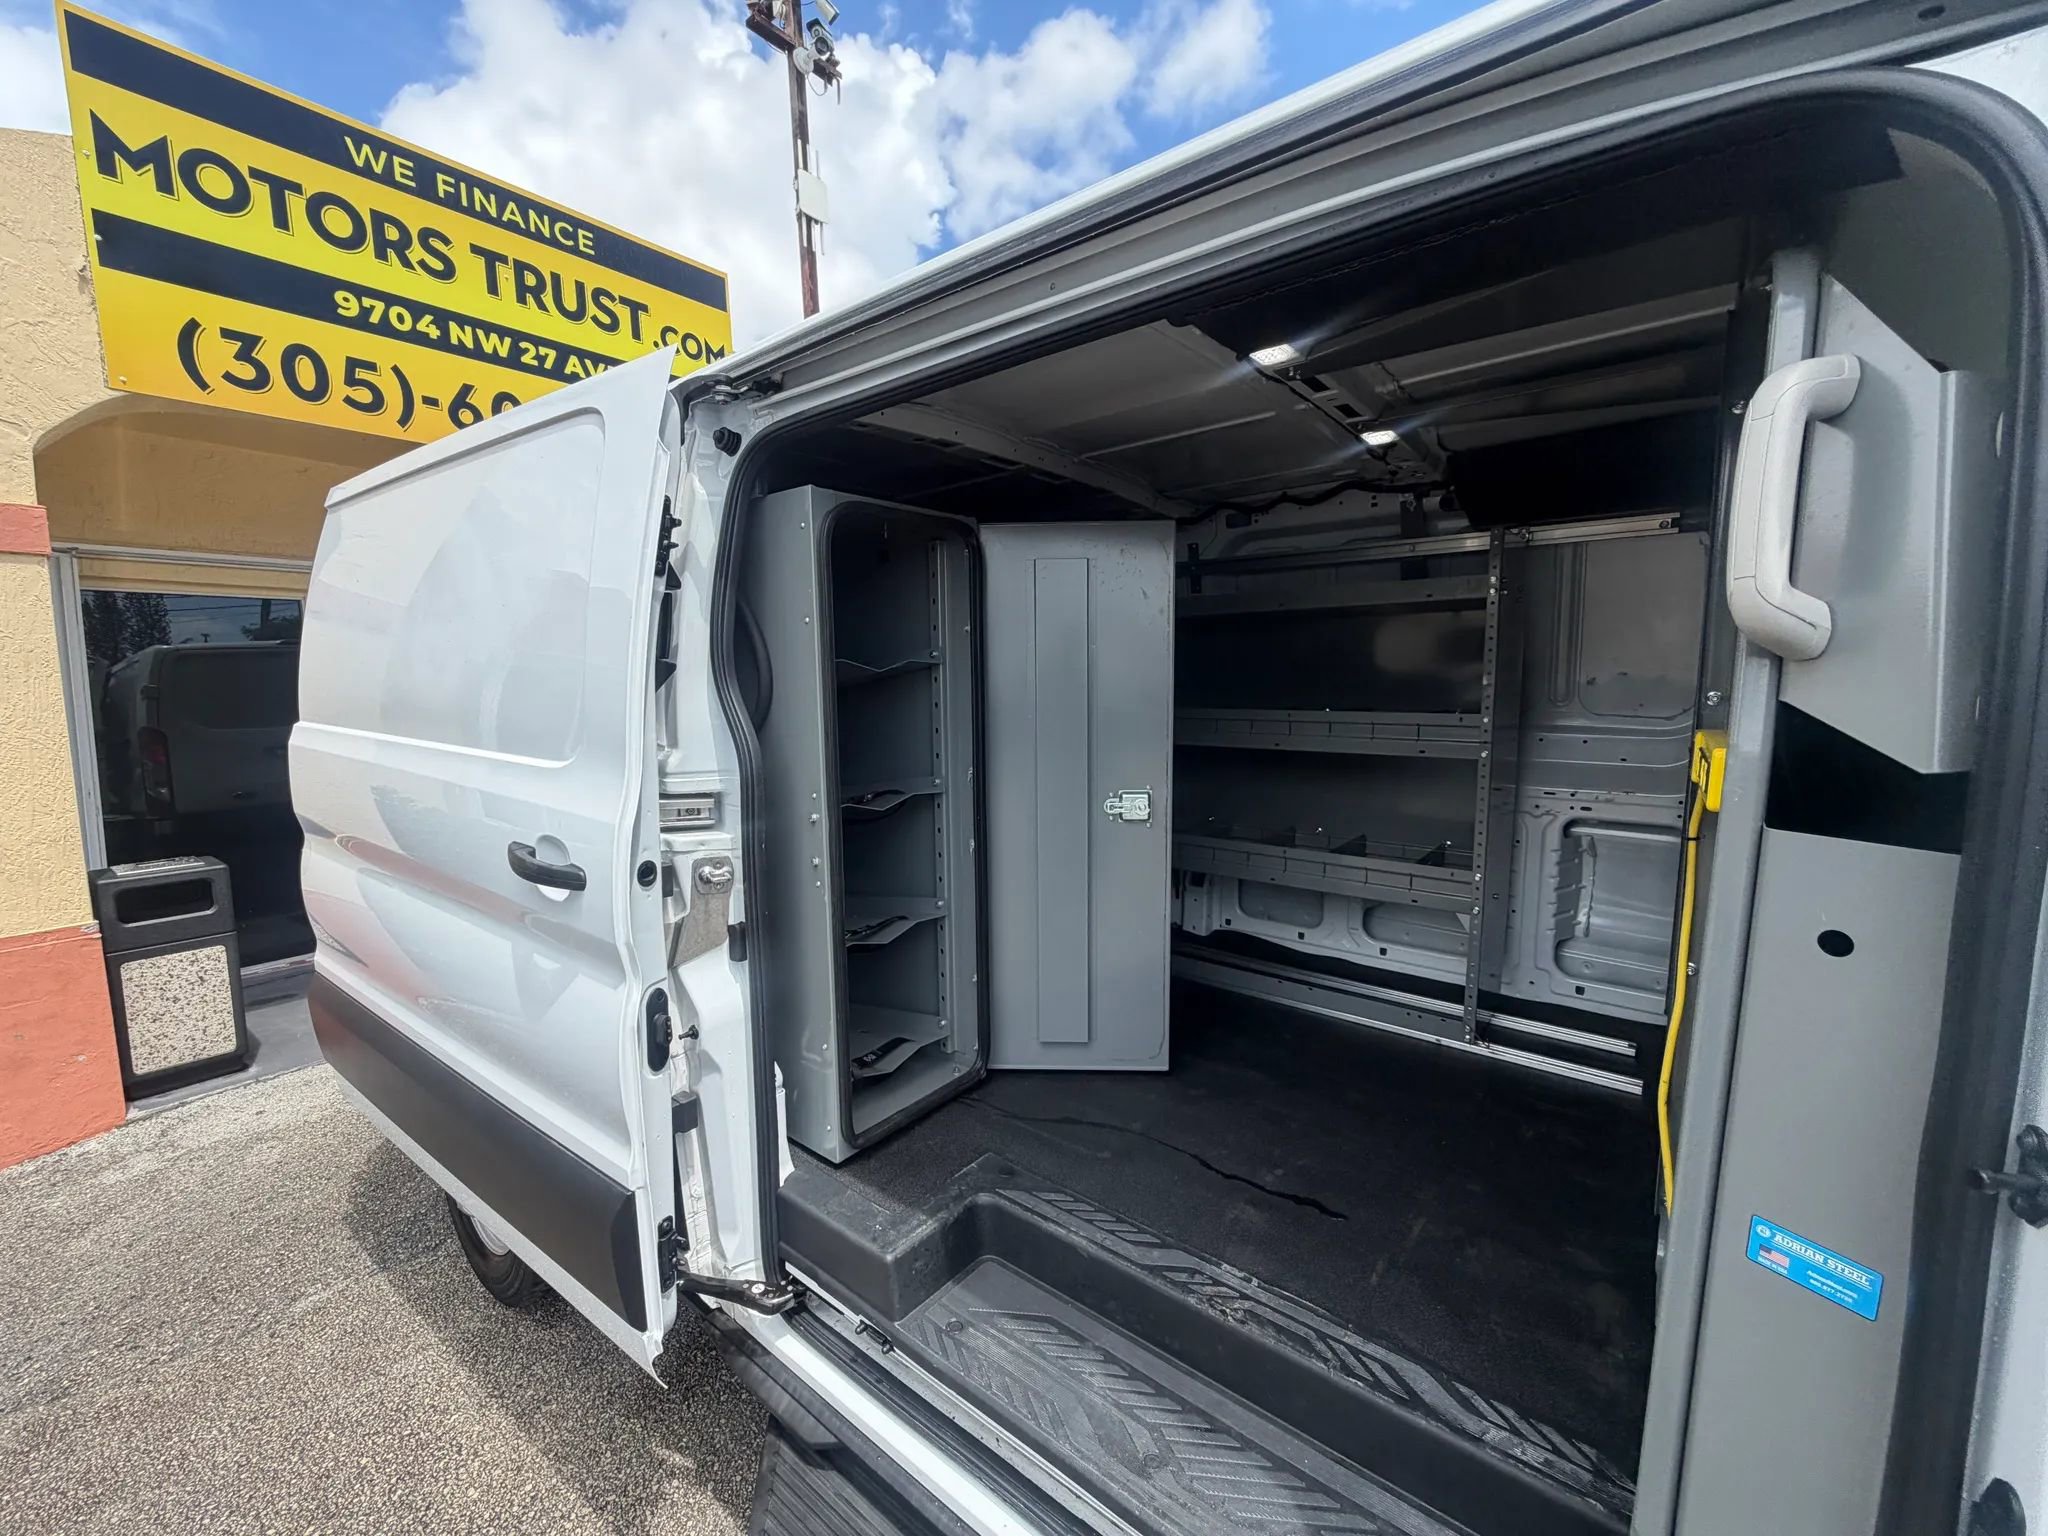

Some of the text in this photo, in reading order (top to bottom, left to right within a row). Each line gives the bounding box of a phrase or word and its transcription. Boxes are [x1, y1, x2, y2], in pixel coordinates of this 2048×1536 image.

[90, 108, 458, 283] MOTORS
[344, 136, 596, 256] WE FINANCE
[334, 290, 615, 379] 9704 NW 27 AV
[1773, 1231, 1825, 1264] ADRIAN
[1826, 1258, 1870, 1286] STEEL
